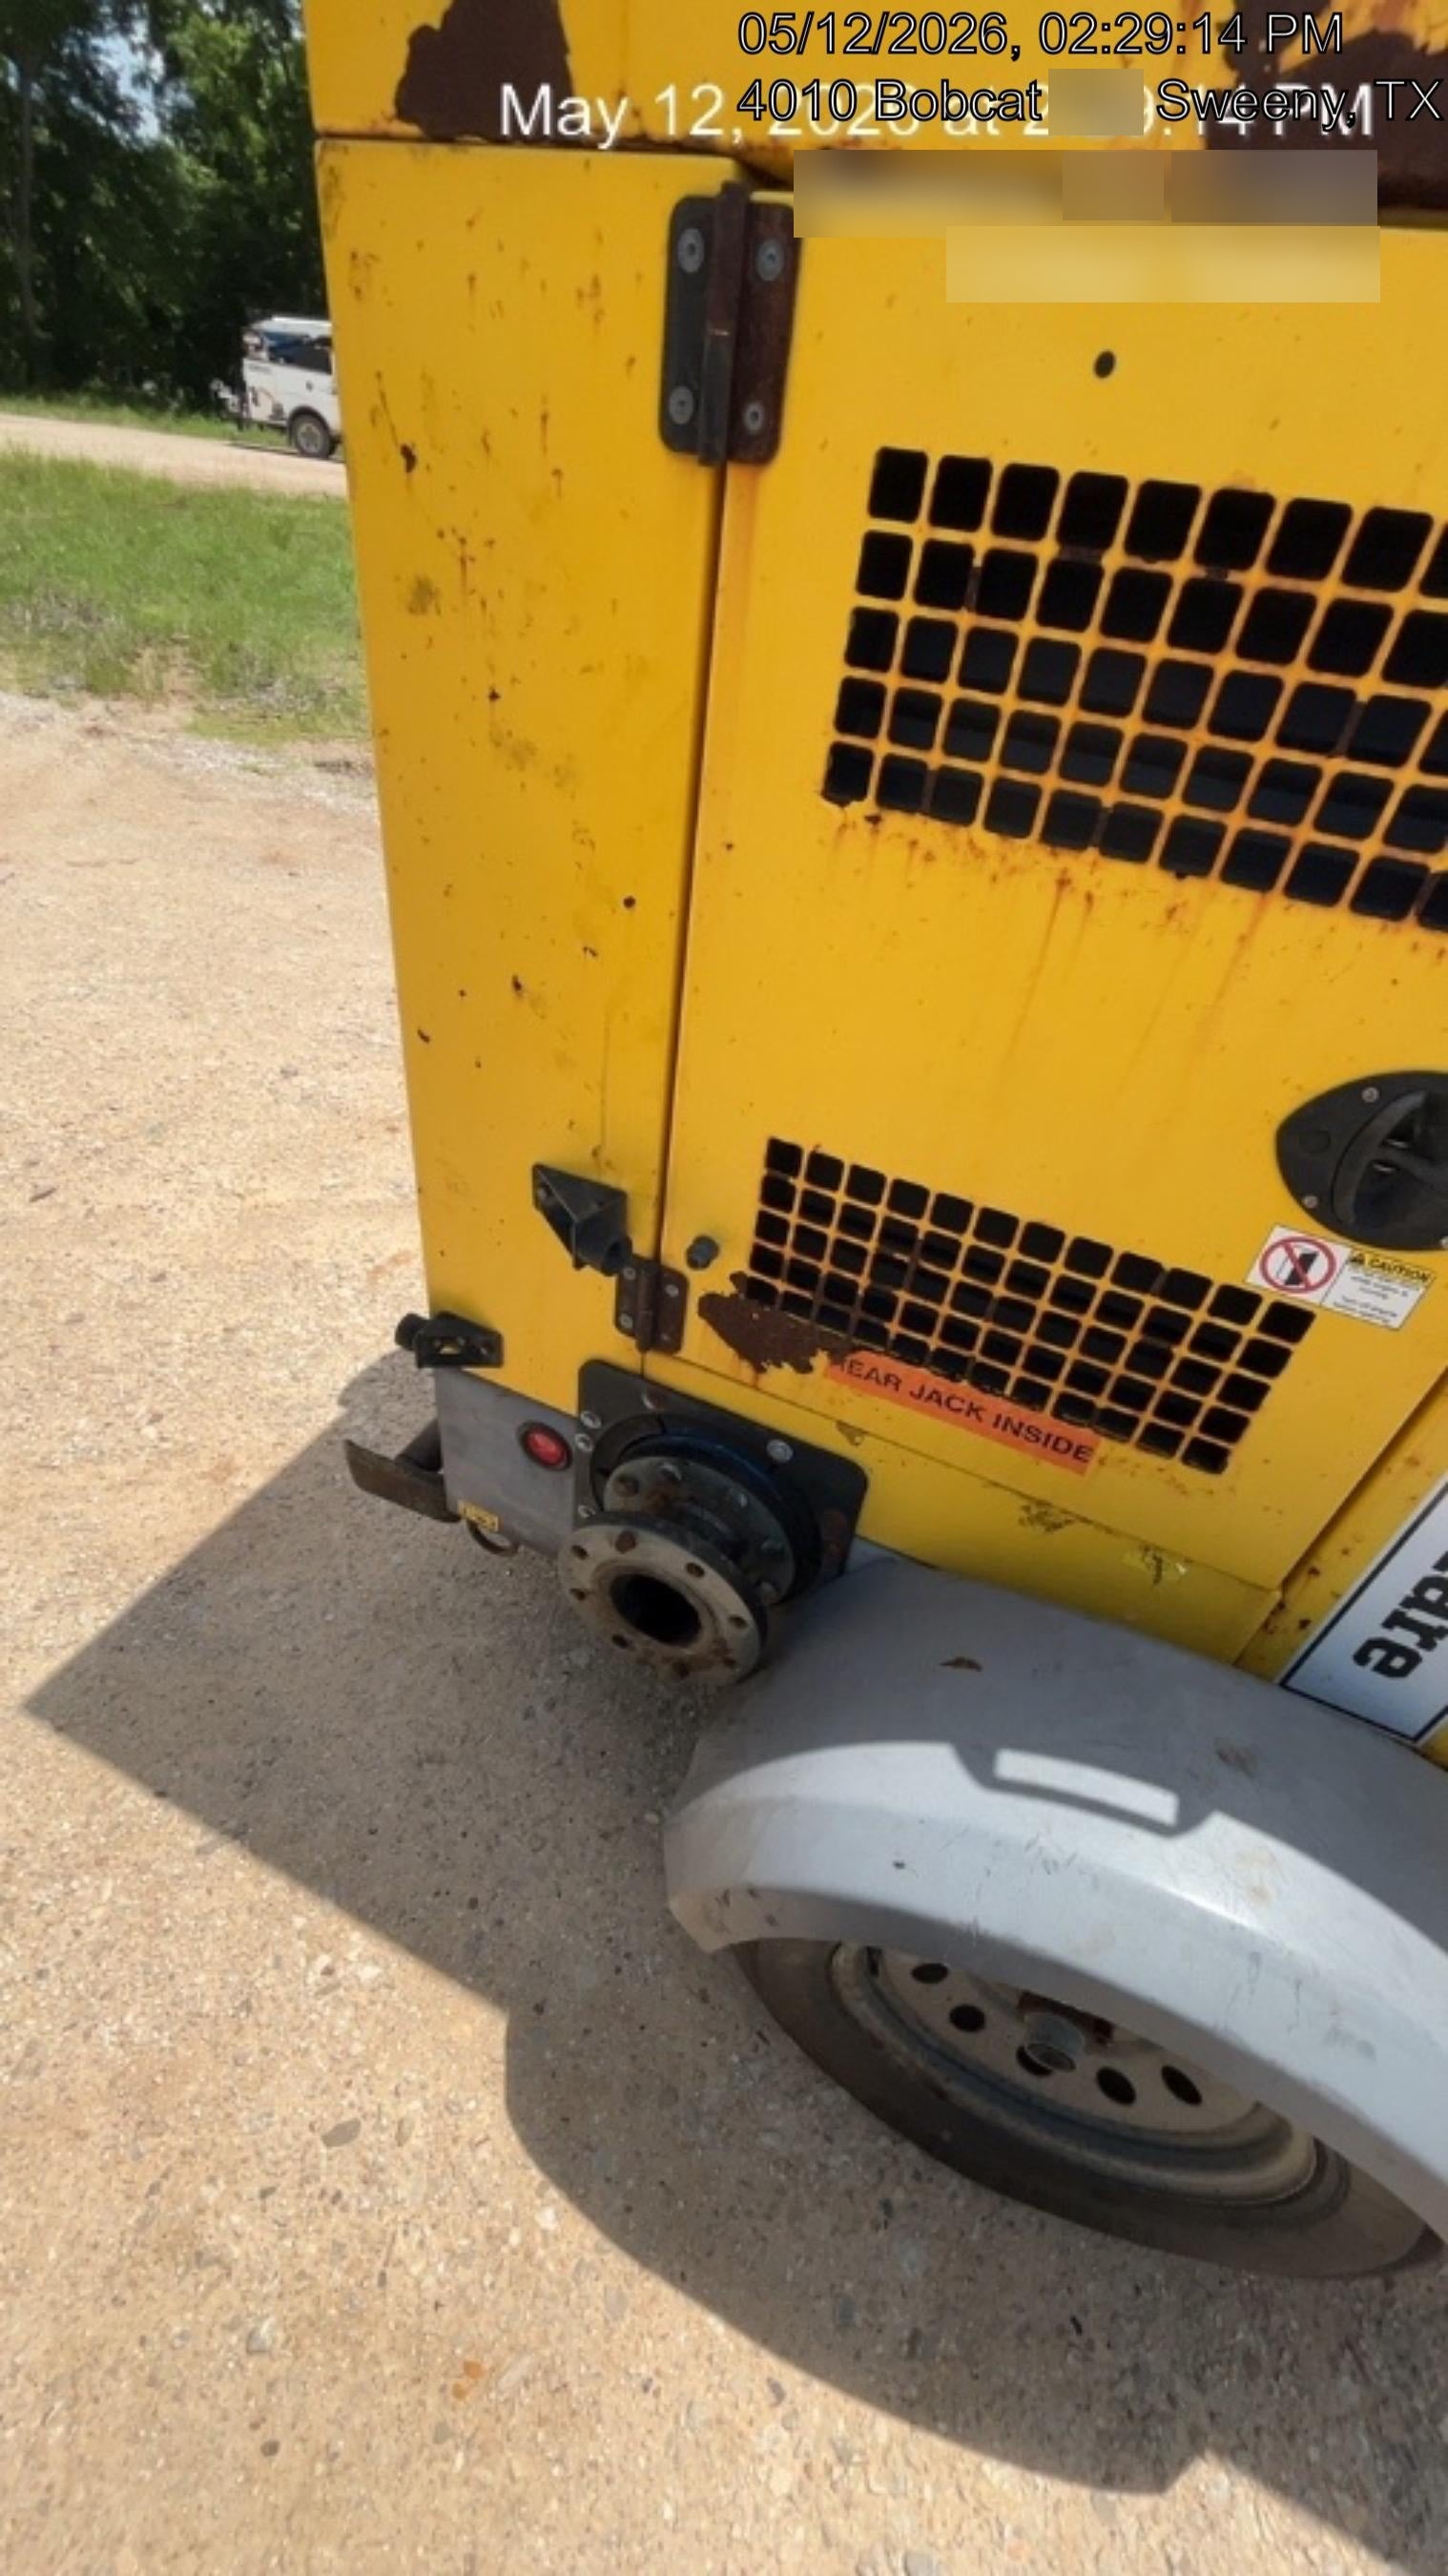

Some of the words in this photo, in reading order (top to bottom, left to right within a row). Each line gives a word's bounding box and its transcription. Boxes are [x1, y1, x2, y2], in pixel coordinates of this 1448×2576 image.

[908, 1383, 984, 1423] JACK
[992, 1412, 1094, 1465] INSIDE
[1353, 1550, 1448, 1679] are
